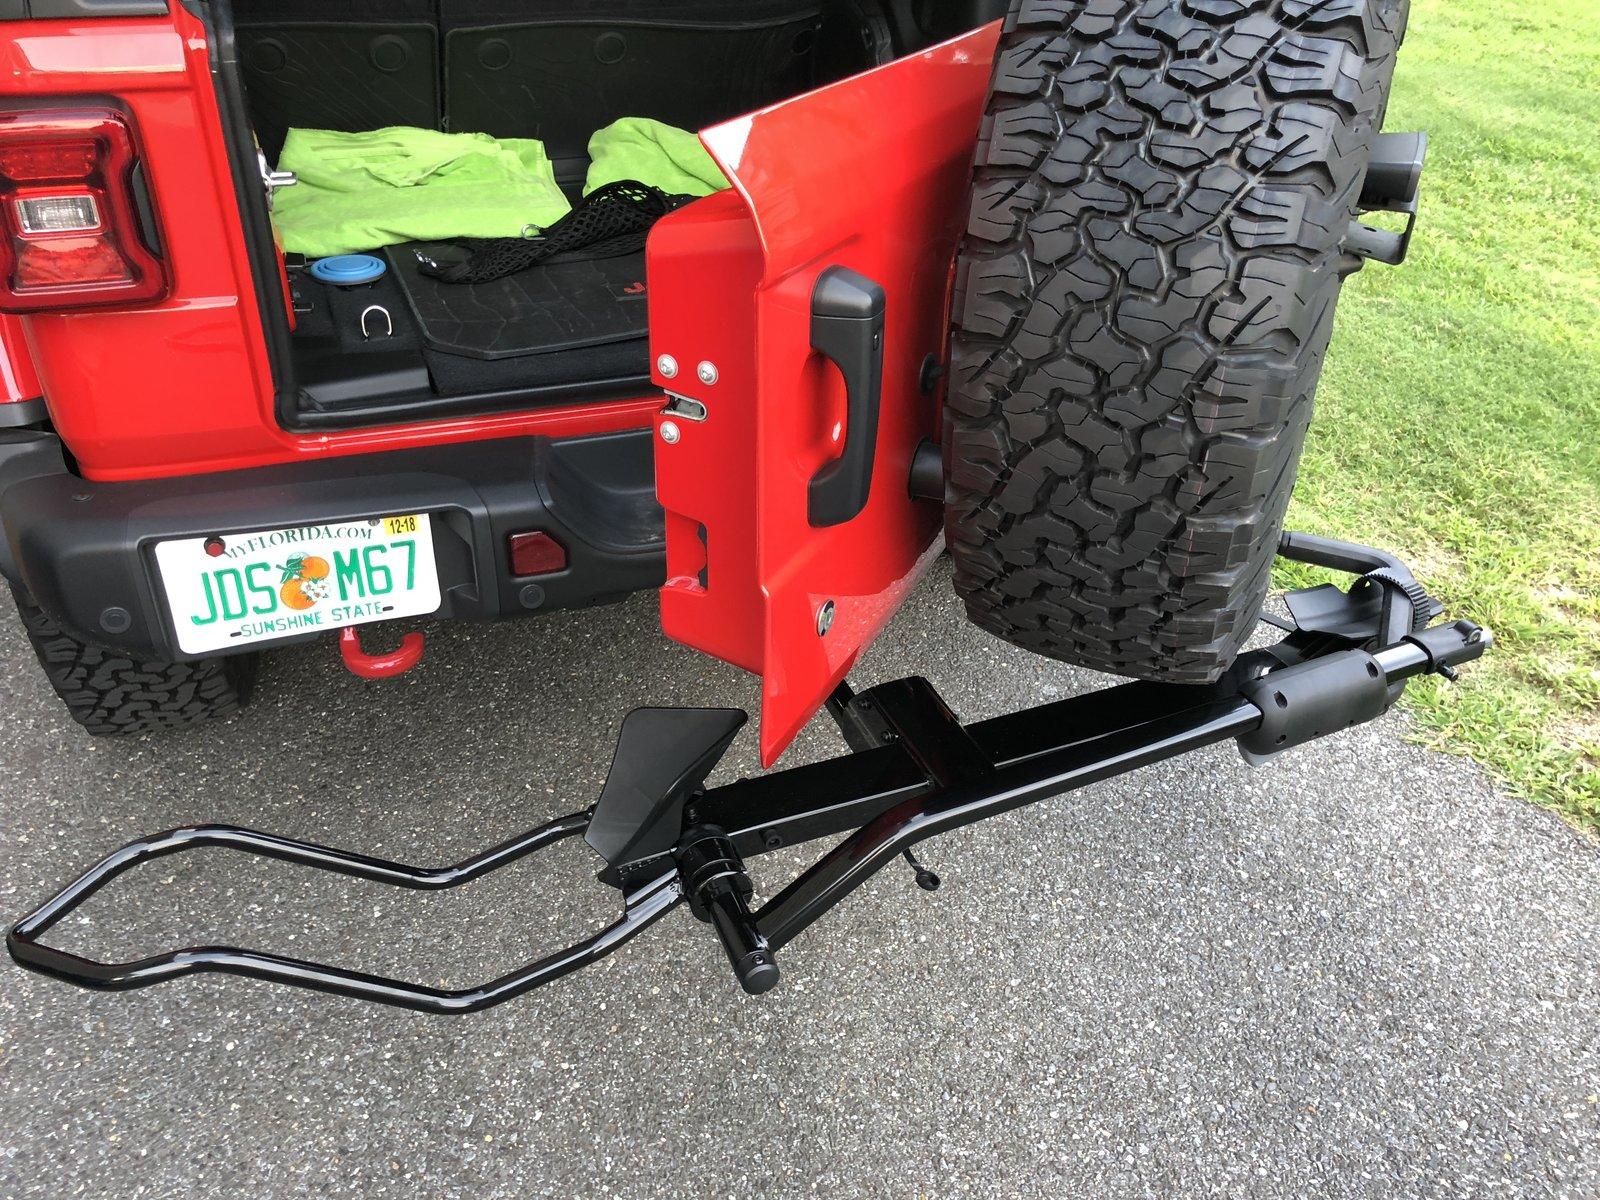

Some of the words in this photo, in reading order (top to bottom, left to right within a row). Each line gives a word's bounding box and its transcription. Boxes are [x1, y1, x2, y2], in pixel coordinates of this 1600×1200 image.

[389, 517, 416, 534] 12-18
[191, 562, 278, 626] JDS
[333, 539, 416, 601] M67
[240, 611, 324, 638] SUNSHINE
[331, 601, 384, 622] STATE
